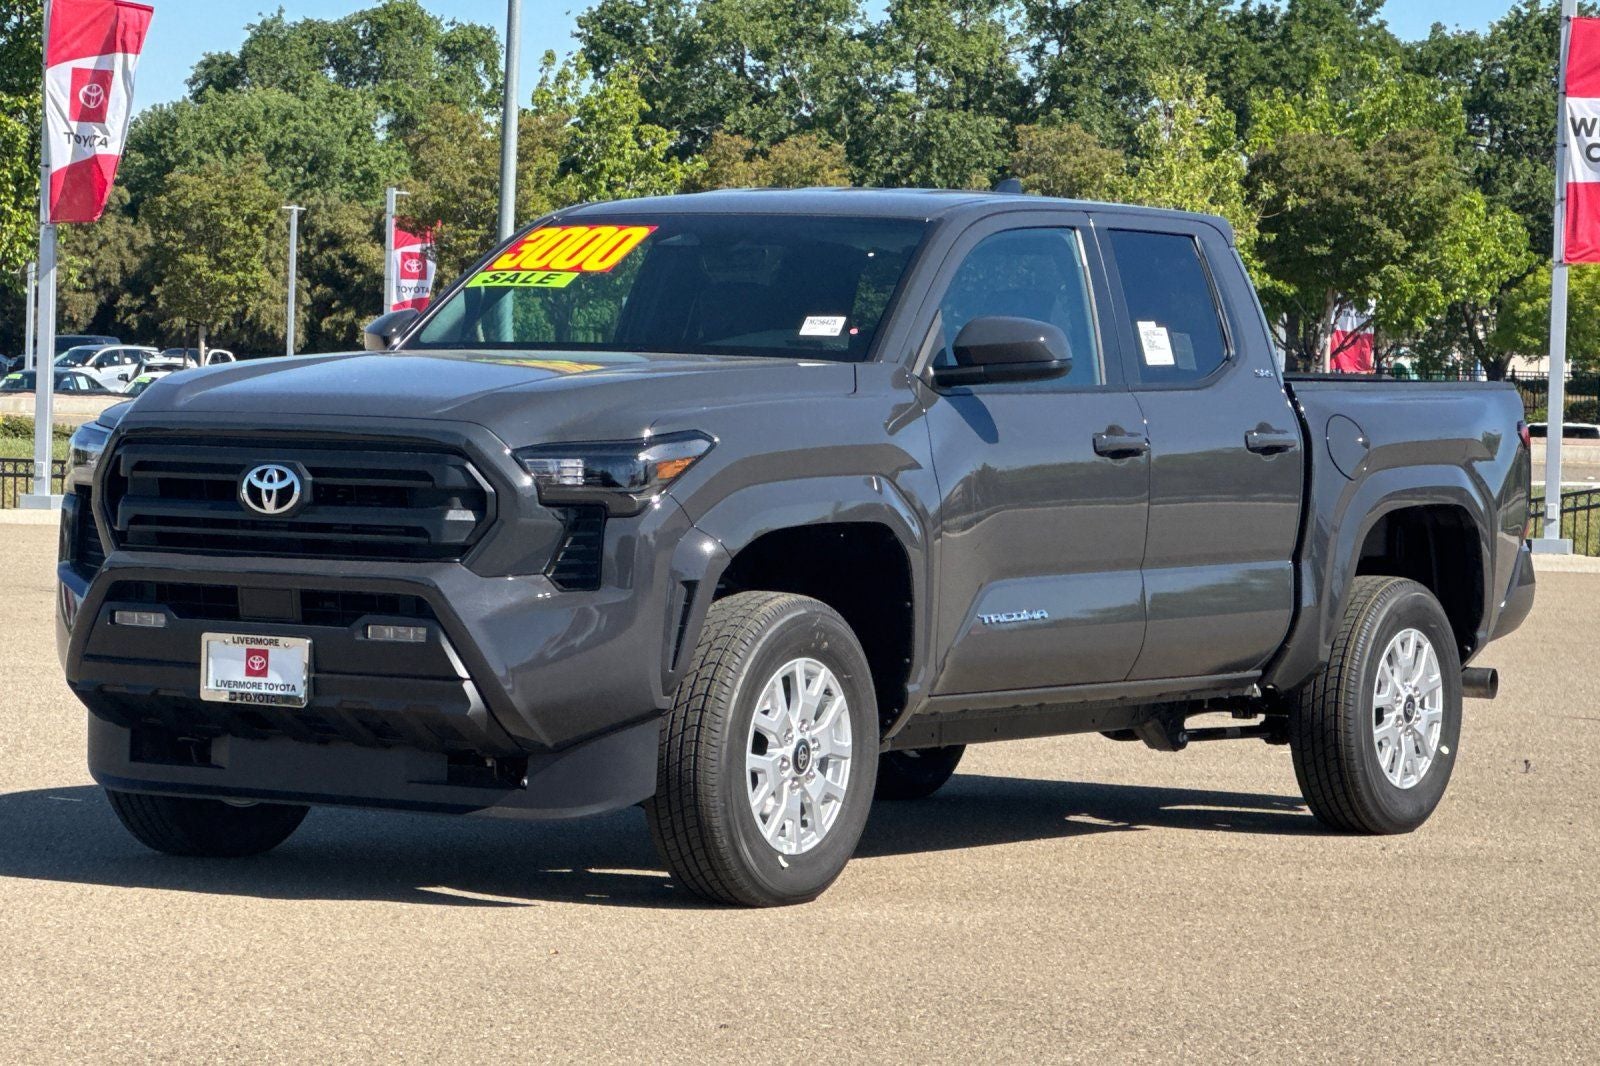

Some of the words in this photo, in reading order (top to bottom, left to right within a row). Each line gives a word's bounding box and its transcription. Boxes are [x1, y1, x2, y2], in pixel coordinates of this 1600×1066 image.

[1570, 117, 1600, 137] W
[492, 226, 650, 271] 3000
[482, 273, 562, 285] SALE
[396, 285, 430, 294] TOYOTA
[232, 635, 280, 647] LIVERMORE
[215, 679, 262, 691] LIVERMORE
[264, 682, 297, 693] TOYOTA
[240, 692, 277, 703] TOYOTA
